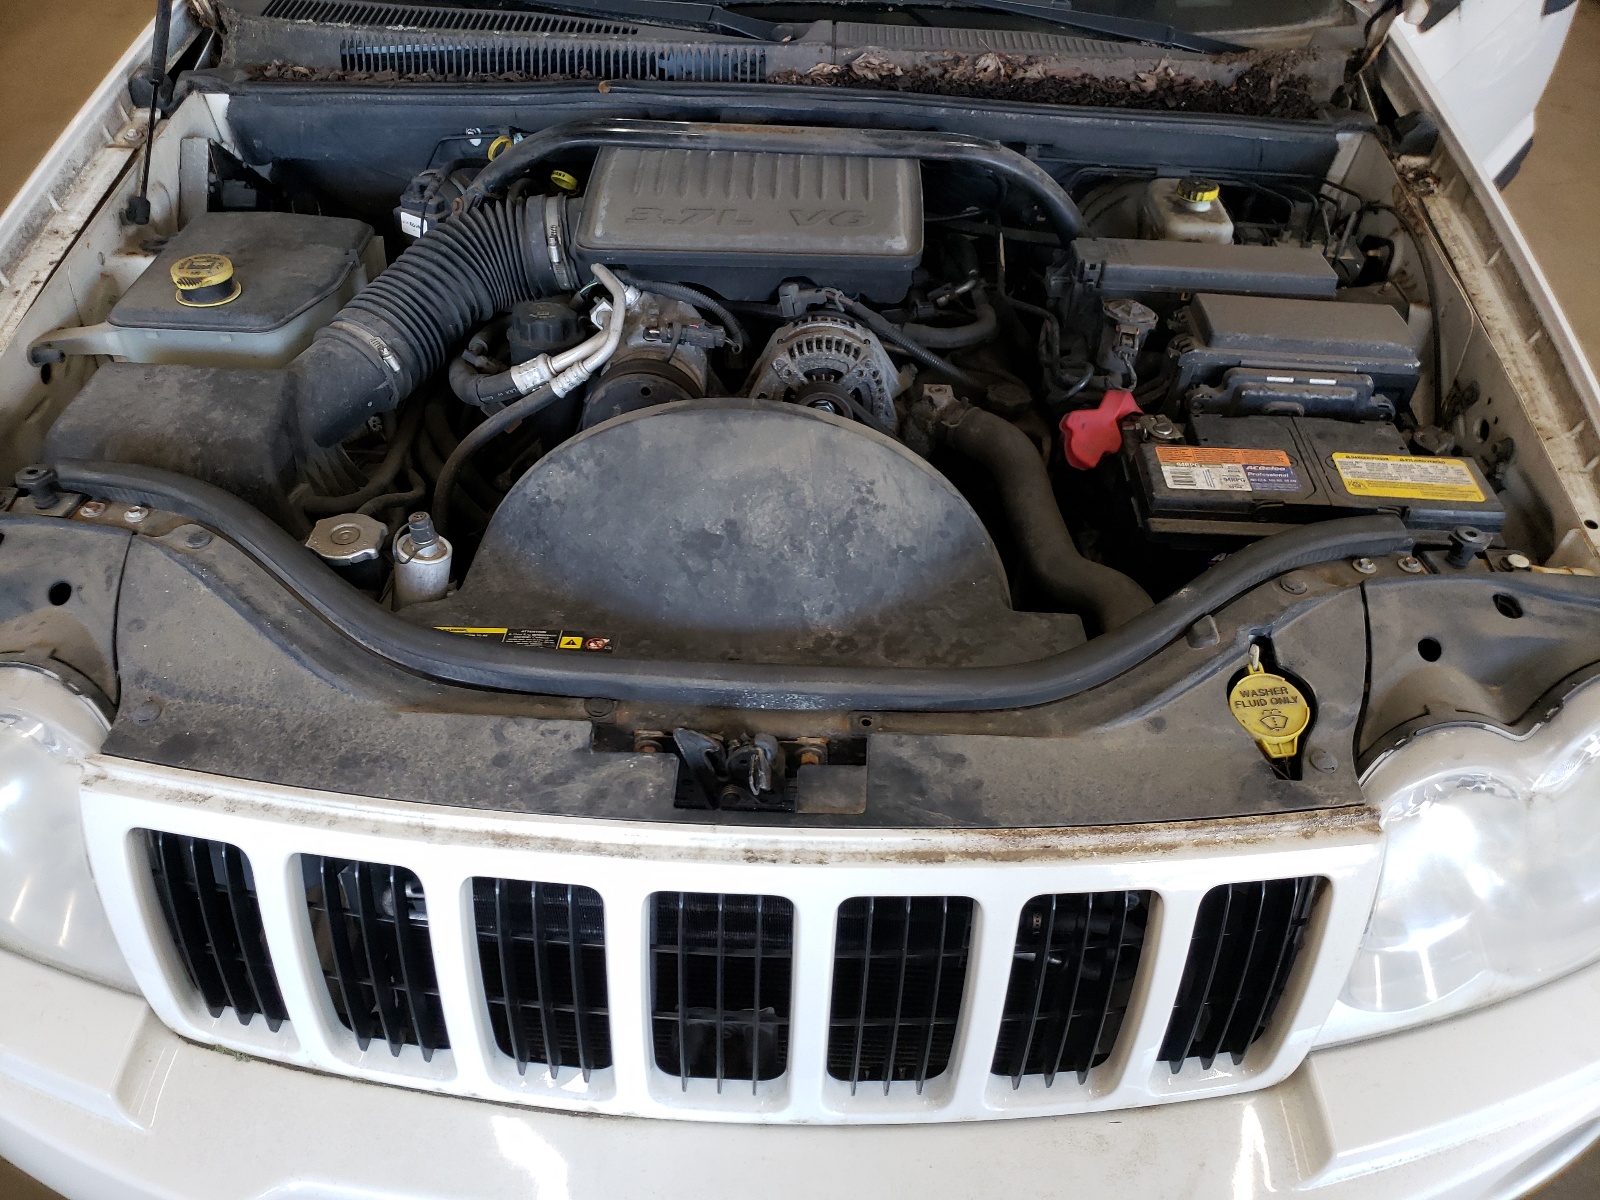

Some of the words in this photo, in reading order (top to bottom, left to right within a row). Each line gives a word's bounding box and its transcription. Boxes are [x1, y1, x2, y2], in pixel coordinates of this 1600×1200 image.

[625, 206, 753, 226] 3.7L
[788, 207, 874, 227] V6
[1239, 686, 1289, 697] WASHER
[1234, 698, 1268, 708] FLUID
[1270, 695, 1298, 705] ONLY
